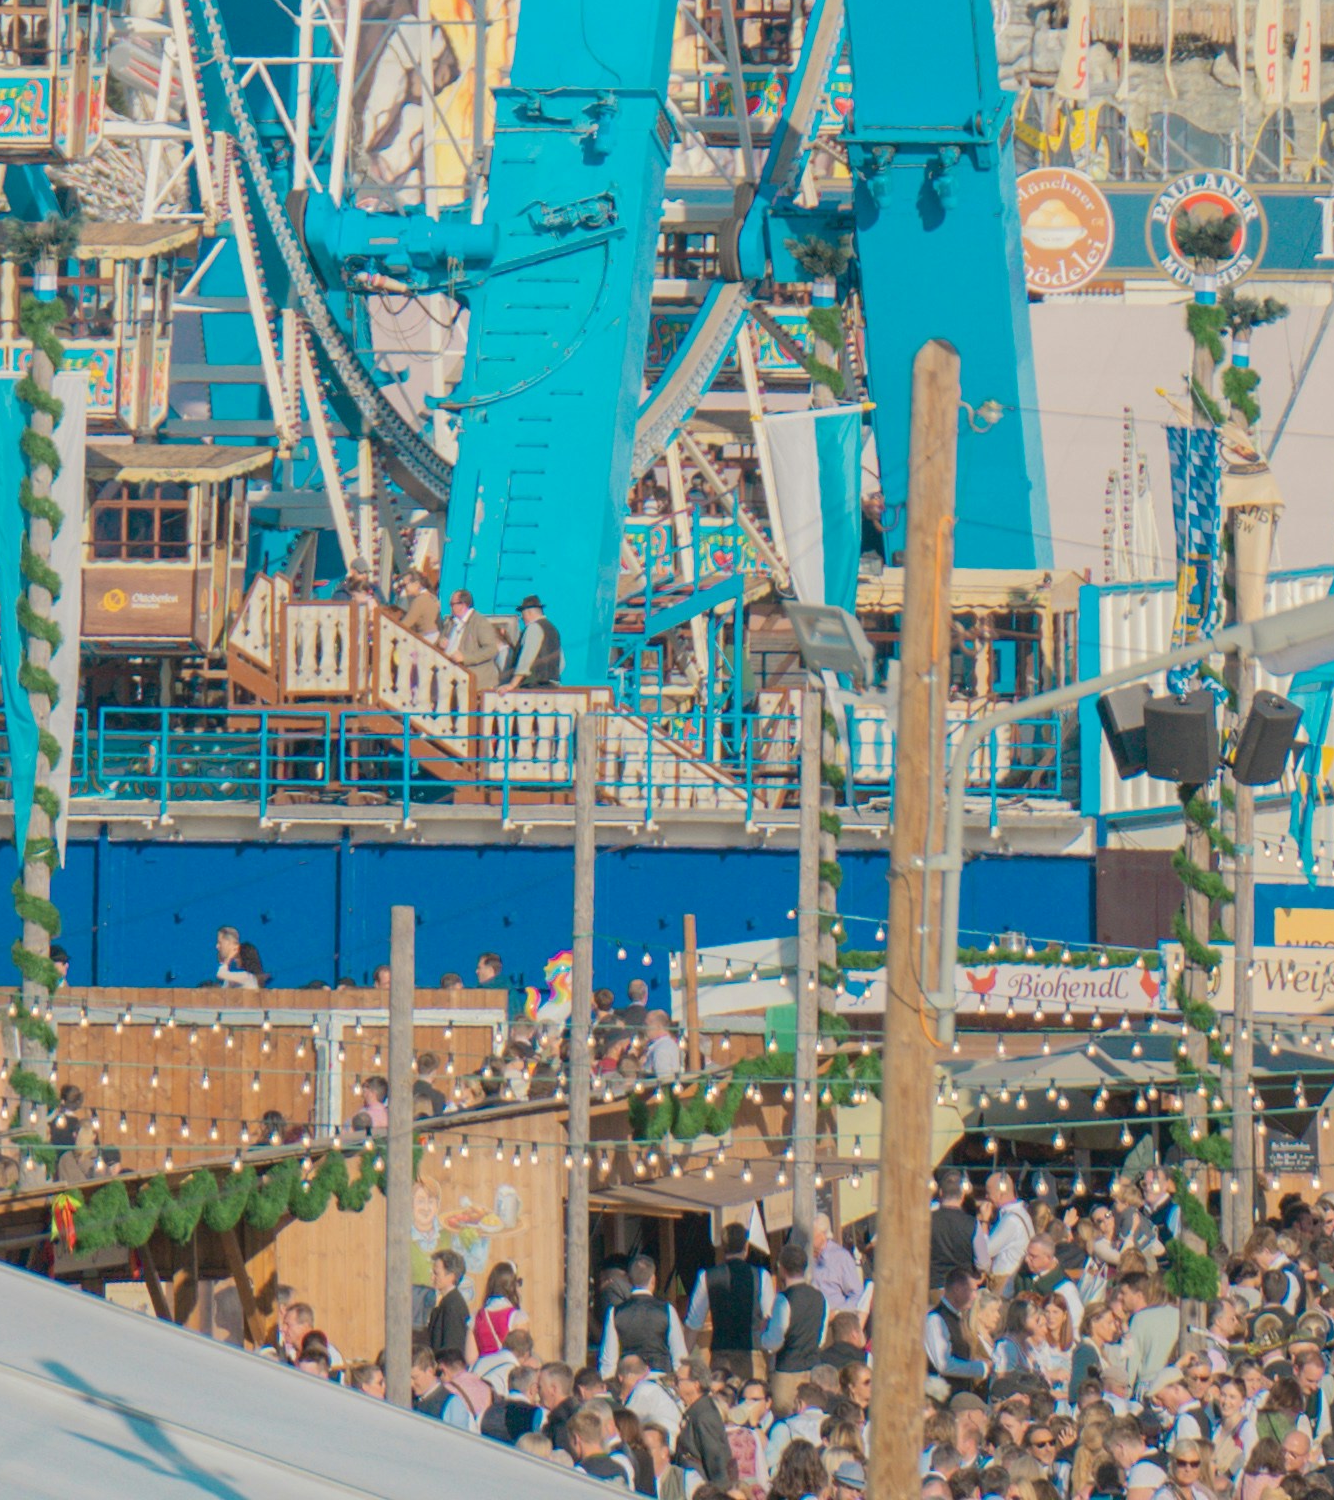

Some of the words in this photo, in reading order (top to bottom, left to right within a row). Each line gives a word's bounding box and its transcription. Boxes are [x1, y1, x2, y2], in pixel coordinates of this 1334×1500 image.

[1152, 172, 1259, 225] PAULANER
[1024, 238, 1107, 288] nödelei
[1008, 970, 1129, 1000] Biohendl
